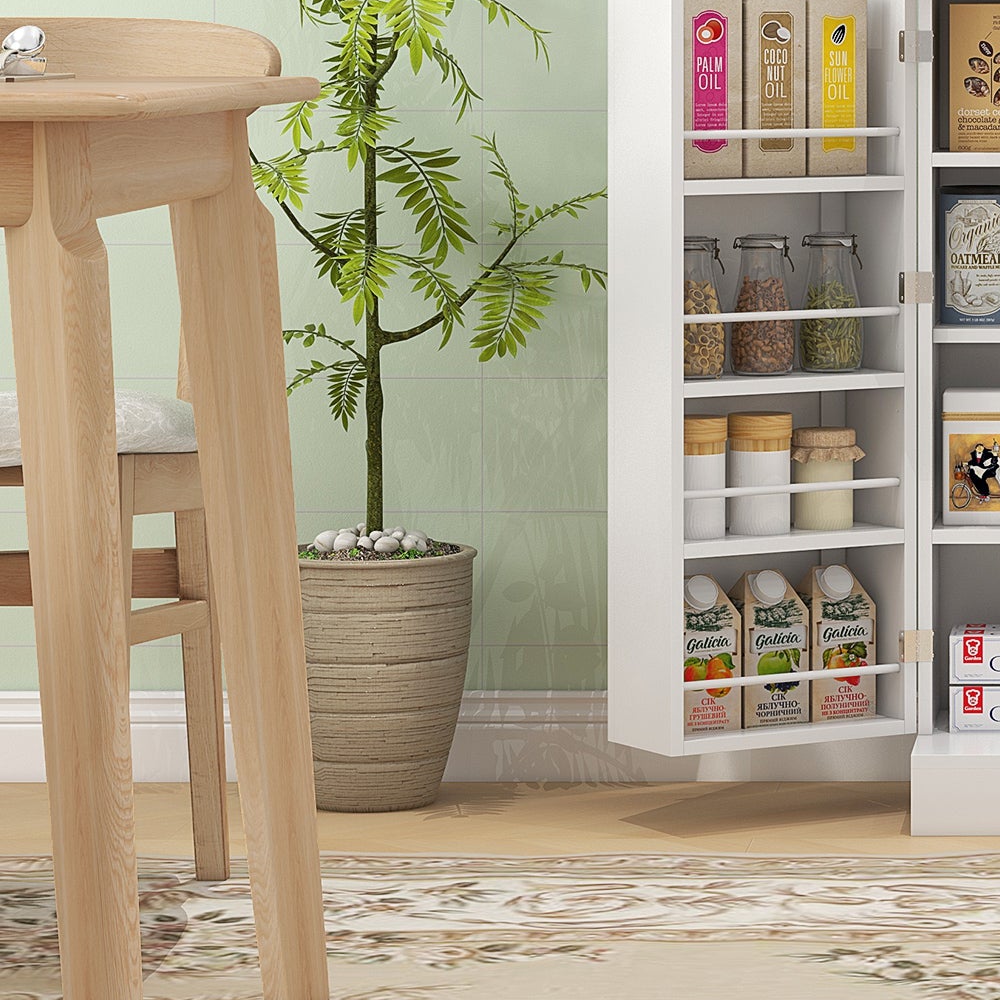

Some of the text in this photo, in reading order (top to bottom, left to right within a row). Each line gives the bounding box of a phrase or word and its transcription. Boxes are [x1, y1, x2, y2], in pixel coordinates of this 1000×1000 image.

[696, 57, 723, 72] PALM
[764, 49, 788, 65] COCO
[830, 51, 848, 66] SUN
[766, 66, 784, 81] NUT
[825, 67, 852, 83] FLOWER
[698, 74, 721, 90] OIL
[765, 82, 787, 98] OIL
[828, 84, 849, 100] OIL
[958, 108, 990, 116] dorset
[958, 116, 996, 124] chocolate
[949, 212, 1000, 250] Organic
[755, 632, 802, 650] Galicia
[823, 625, 868, 643] Galicia
[687, 635, 732, 655] Galicia
[701, 697, 716, 706] СІК
[771, 693, 786, 701] СІК
[824, 694, 867, 702] ЯБЛУЧНО-
[692, 705, 725, 713] ЯБЛУЧНО-
[756, 708, 802, 717] ЧОРНИЧНИЙ
[757, 701, 800, 711] ЯБЛУЧНО-
[821, 700, 870, 710] ПОЛУНИЧНИЙ
[689, 712, 726, 720] ГРУШЕВИЙ
